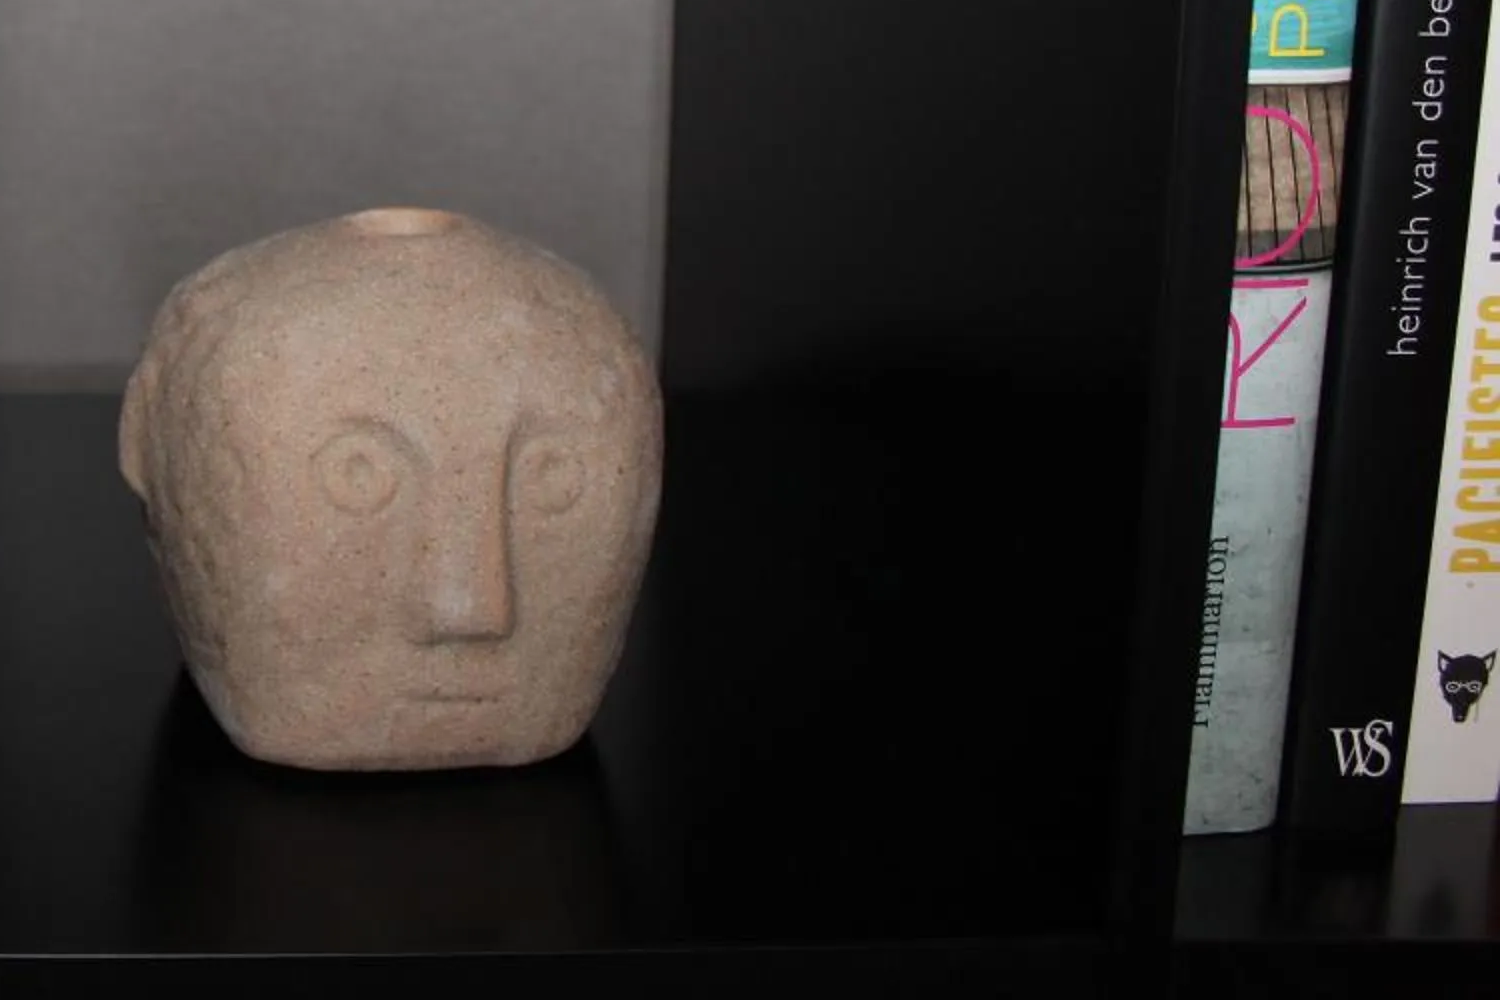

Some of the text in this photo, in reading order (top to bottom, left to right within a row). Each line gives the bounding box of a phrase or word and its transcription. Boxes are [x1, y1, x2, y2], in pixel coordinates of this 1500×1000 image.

[1412, 55, 1448, 121] den
[1412, 139, 1439, 200] van
[1387, 216, 1431, 356] heinrich
